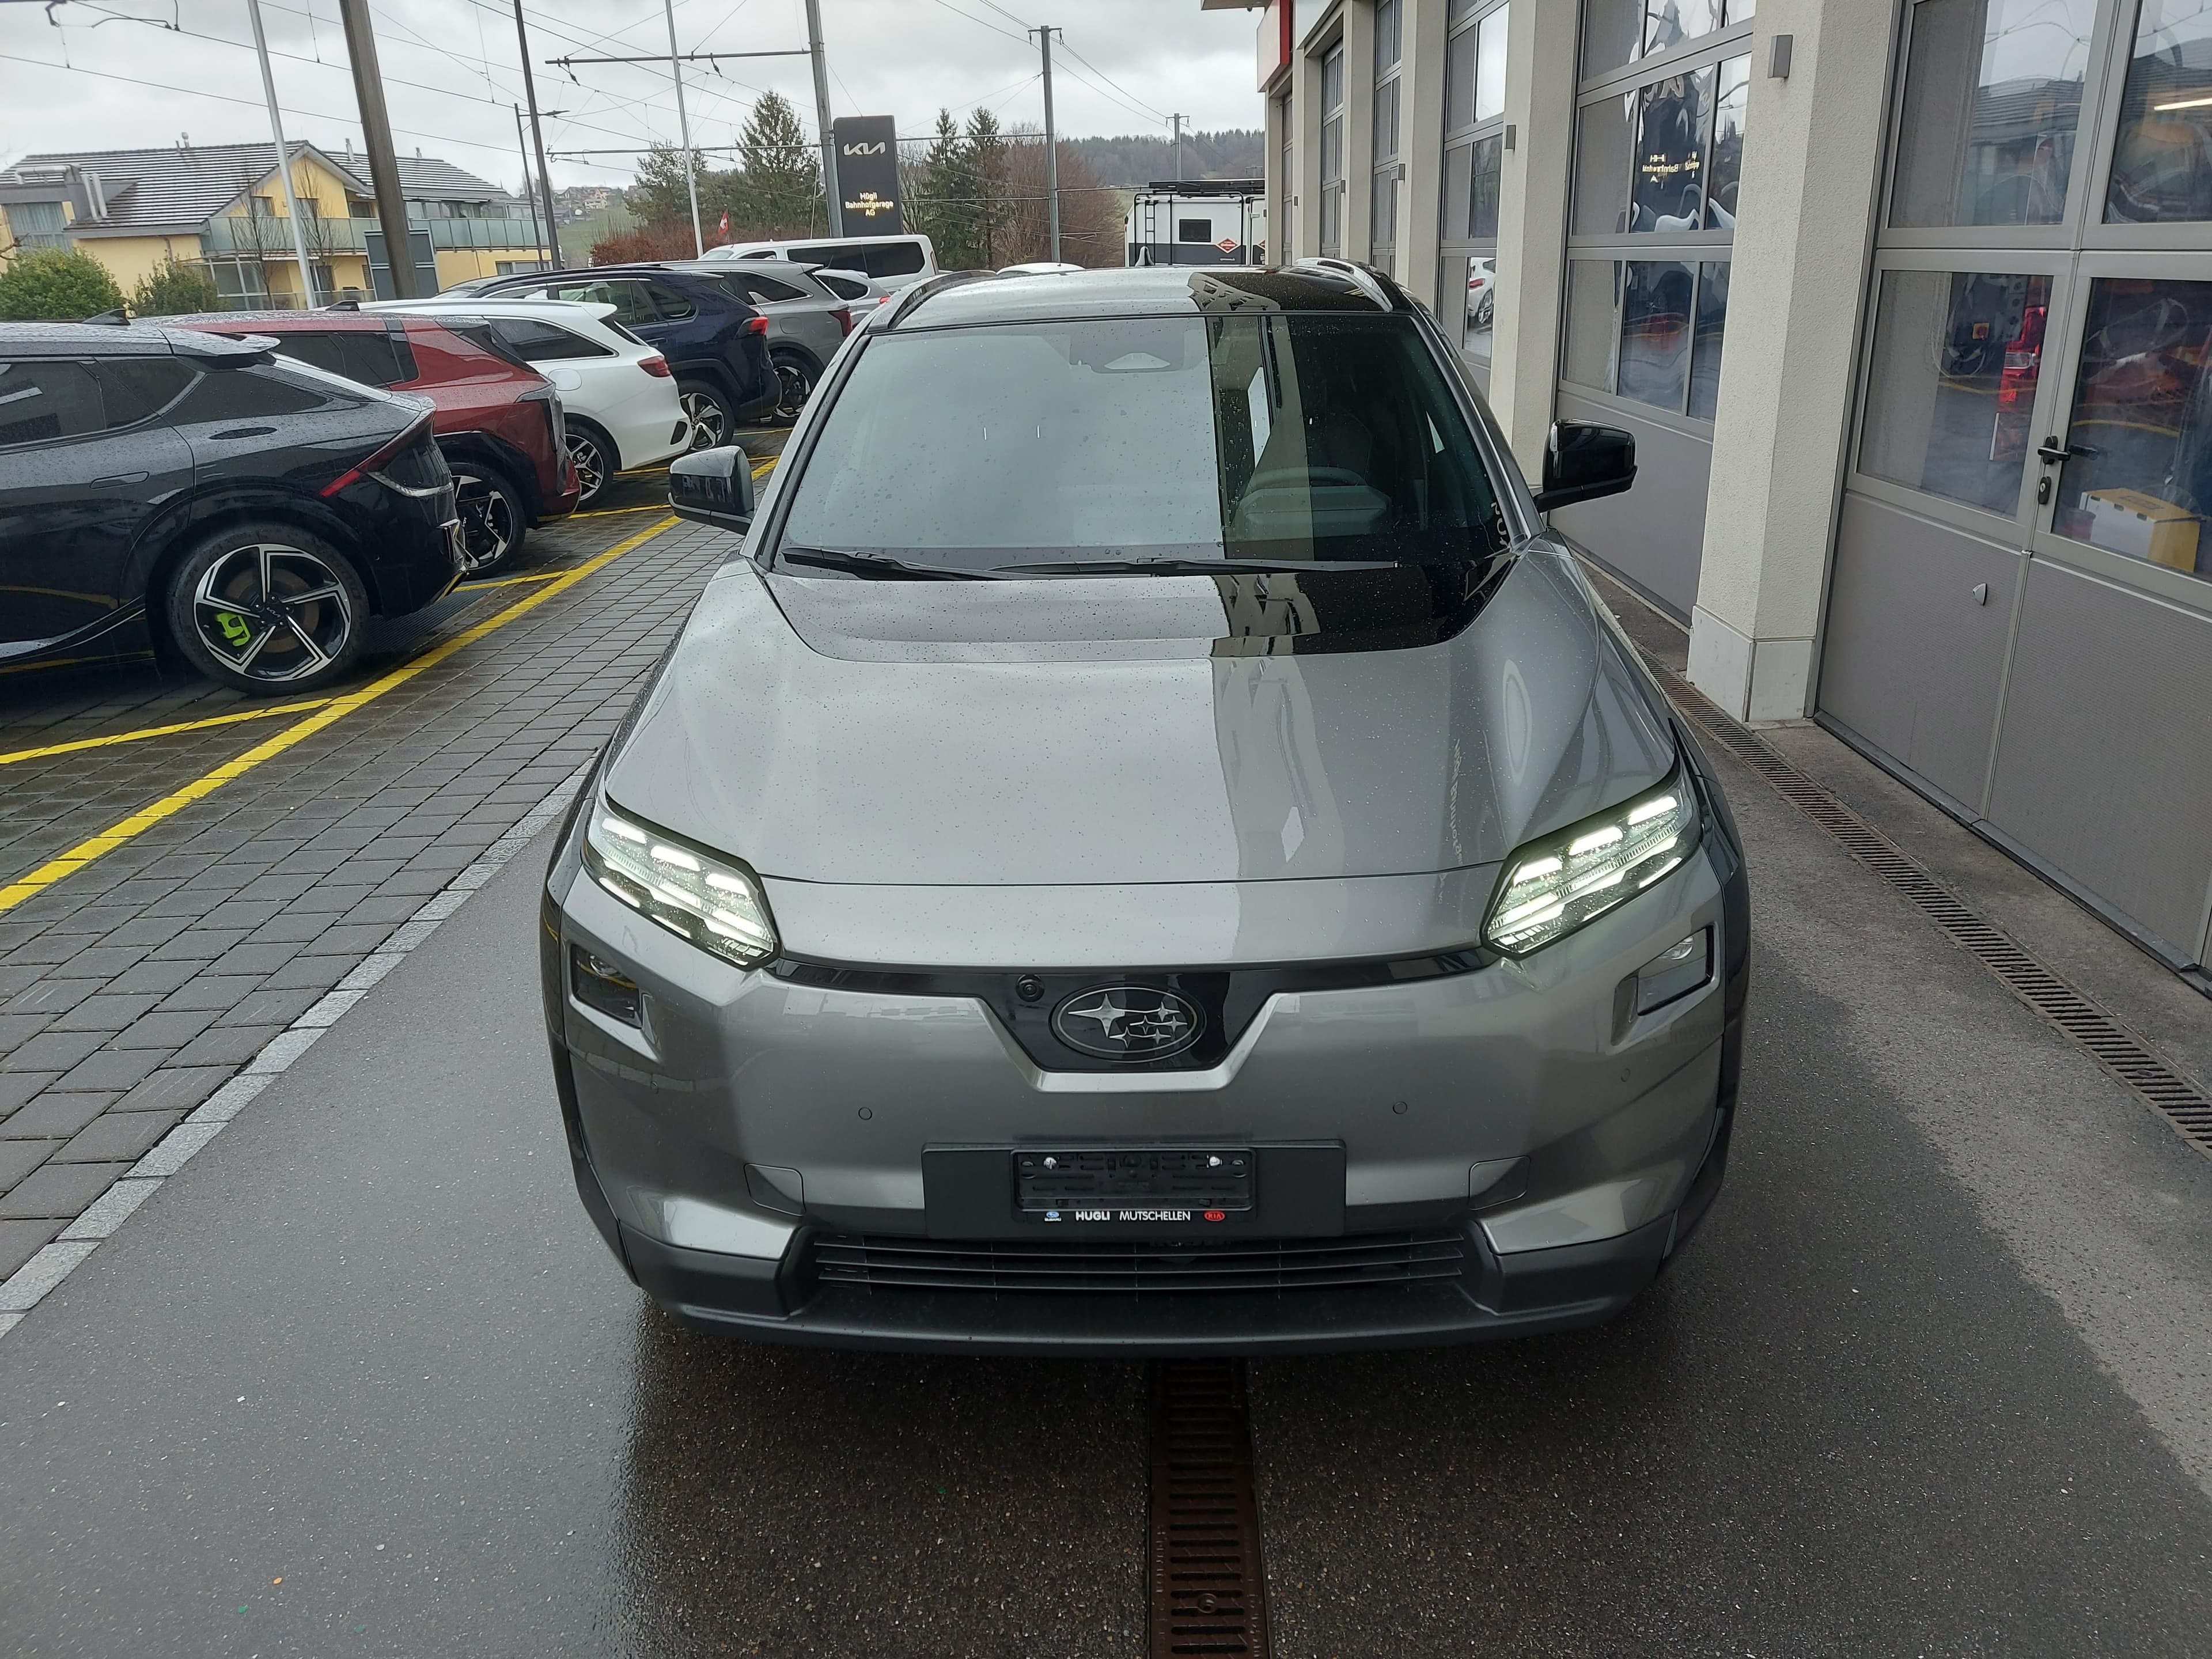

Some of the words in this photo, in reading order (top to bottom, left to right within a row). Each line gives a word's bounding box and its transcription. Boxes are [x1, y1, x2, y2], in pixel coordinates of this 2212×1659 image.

[844, 200, 894, 210] Bahnhofgarage
[865, 209, 876, 217] AG
[1119, 1210, 1191, 1221] MUTSCHELLEN
